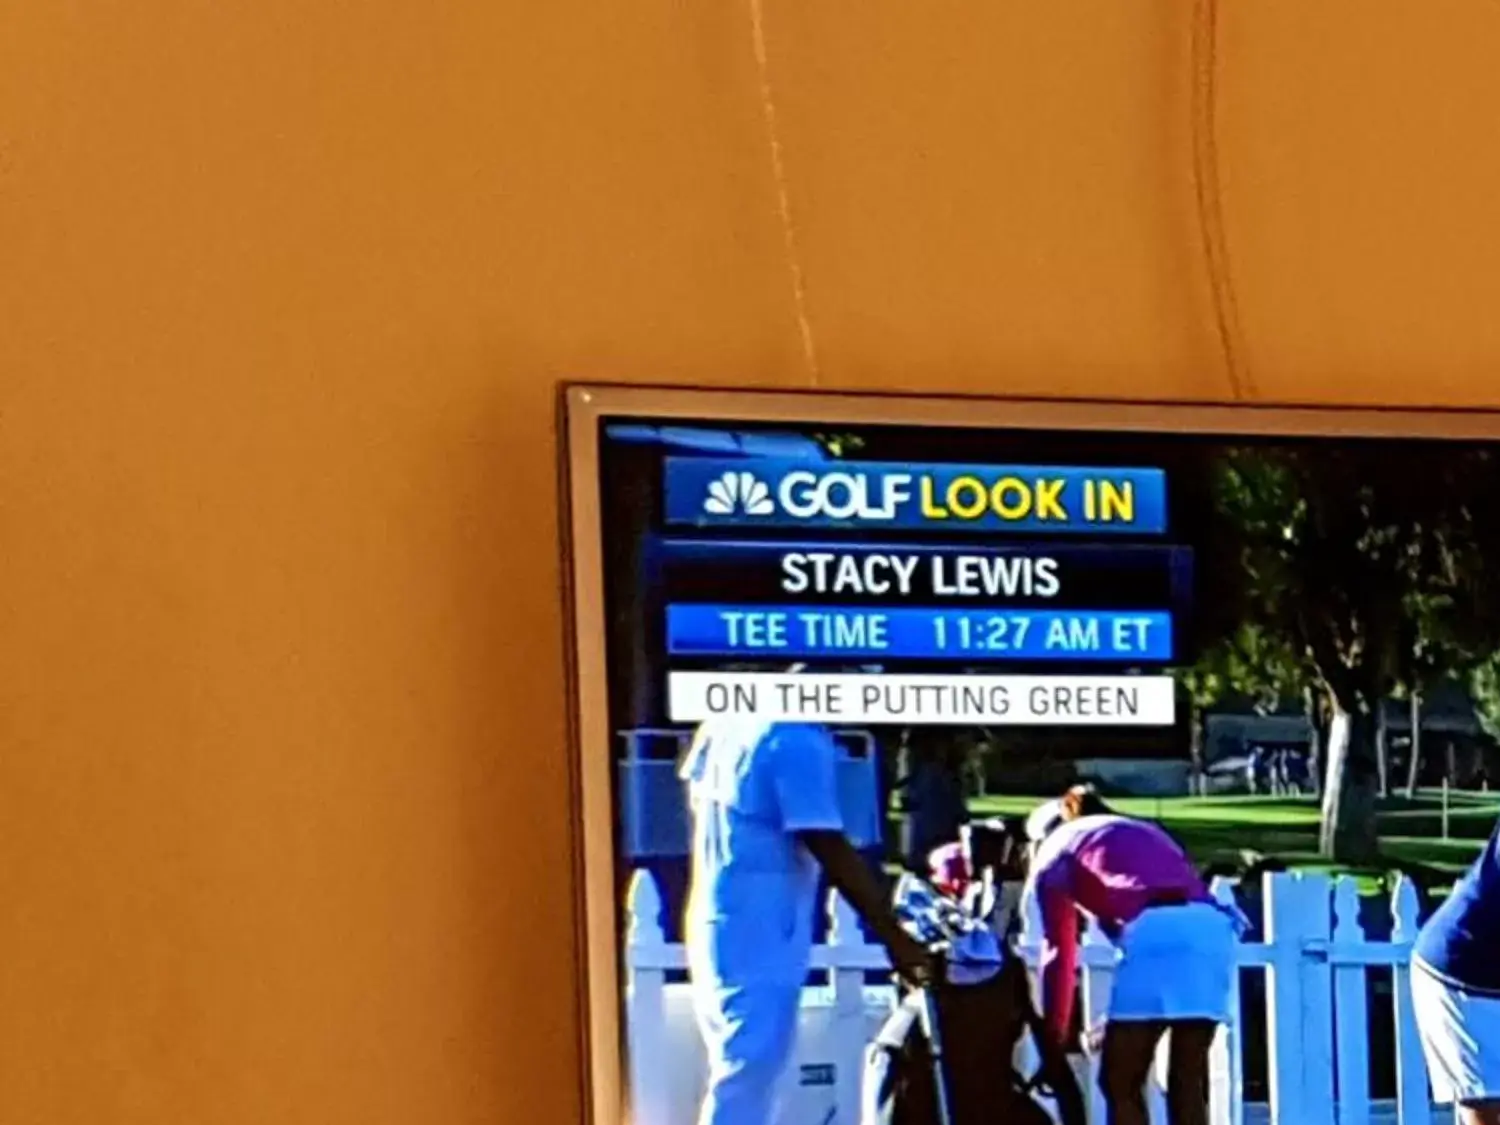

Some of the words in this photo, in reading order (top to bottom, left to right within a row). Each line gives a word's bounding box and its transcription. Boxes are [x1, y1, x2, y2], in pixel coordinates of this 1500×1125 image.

[779, 471, 911, 519] GOLF
[921, 476, 1067, 520] LOOK
[1084, 479, 1133, 521] IN
[781, 552, 919, 595] STACY
[932, 555, 1060, 597] LEWIS
[721, 612, 787, 646] TEE
[801, 613, 887, 648] TIME
[935, 617, 1030, 649] 11:27
[1046, 618, 1099, 649] AM
[1113, 618, 1152, 650] ET
[706, 683, 756, 713] ON
[776, 683, 840, 714] THE
[862, 685, 1009, 714] PUTTING
[1029, 686, 1138, 715] GREEN
